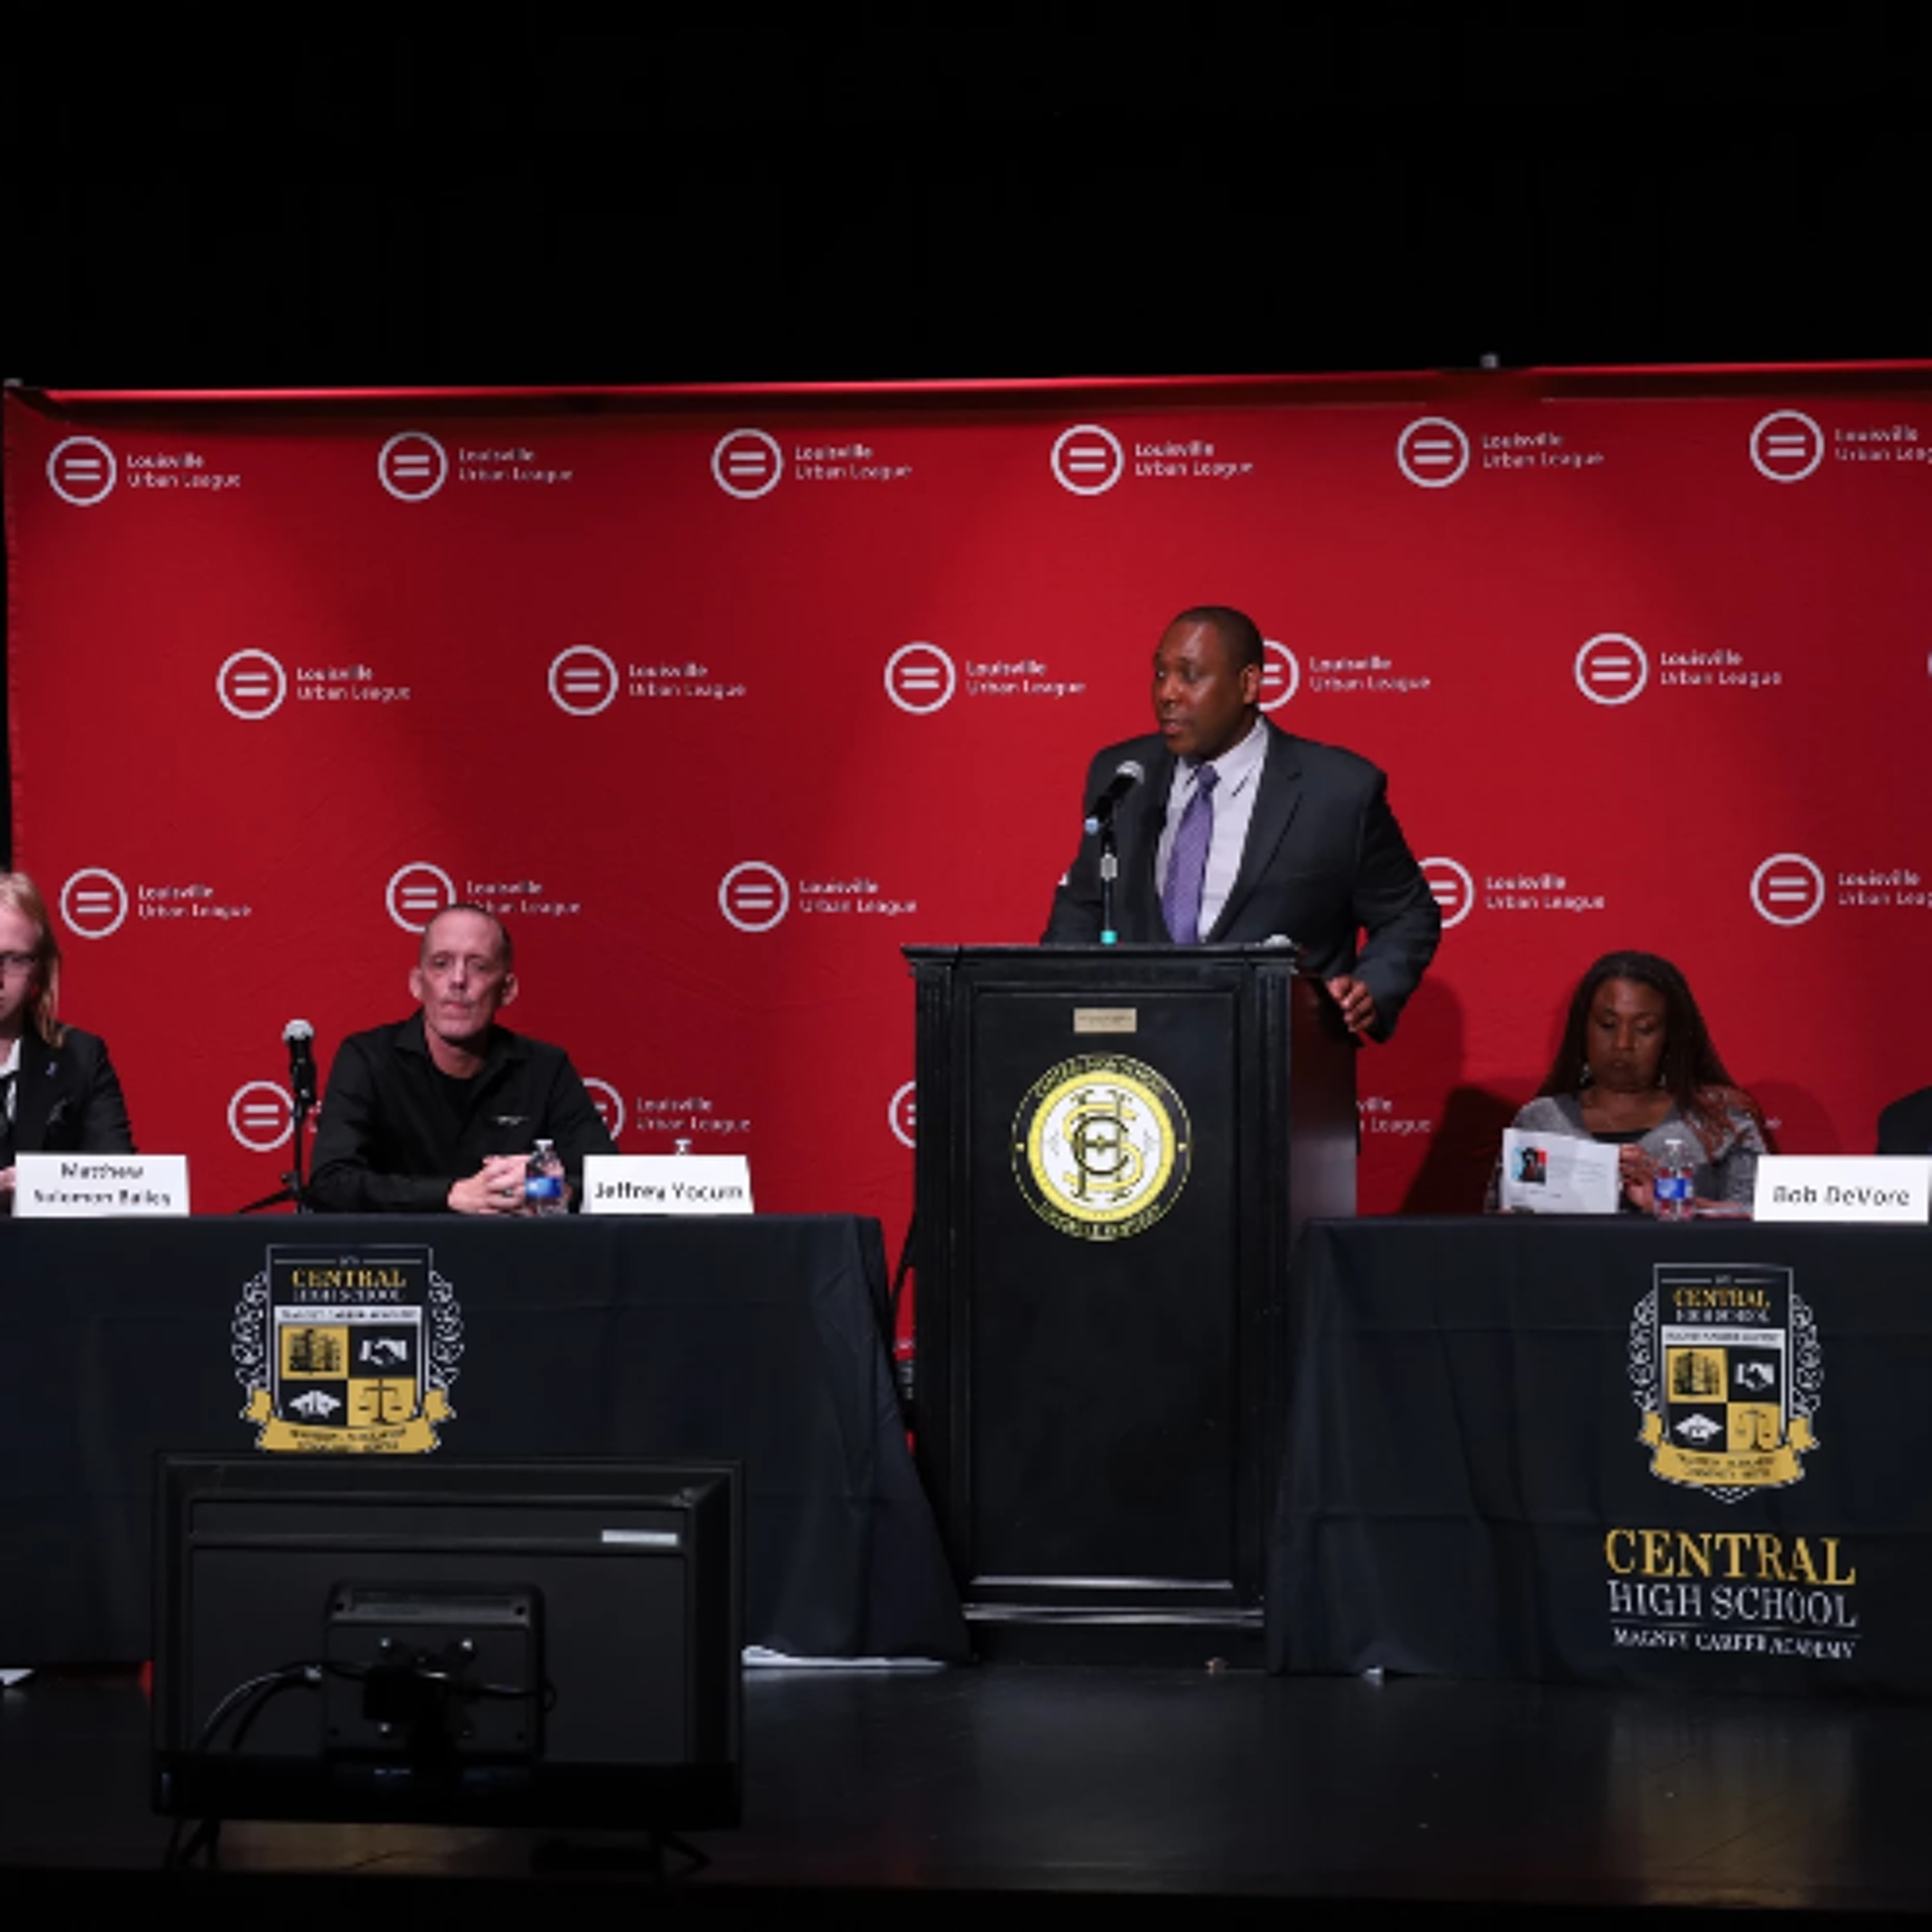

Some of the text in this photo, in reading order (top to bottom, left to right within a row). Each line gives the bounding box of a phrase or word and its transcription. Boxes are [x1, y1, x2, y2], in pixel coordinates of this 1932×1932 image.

[1482, 432, 1562, 449] Louisville
[1835, 425, 1918, 442] Louisville
[459, 448, 535, 462] Louisville
[795, 443, 873, 460] Louisville
[1135, 440, 1214, 457] Louisville
[1835, 448, 1890, 460] Urban
[127, 452, 205, 468] Louisville
[1483, 451, 1604, 468] Urban League
[459, 467, 573, 484] Urban League
[795, 464, 913, 480] Urban League
[1135, 460, 1253, 479] Urban League
[127, 471, 240, 491] Urban League
[1309, 655, 1392, 673] Louisville
[1660, 649, 1743, 666] Louisville
[296, 664, 373, 681] Louisville
[629, 662, 708, 677] Louisville
[965, 659, 1047, 677] Louisville
[1309, 676, 1431, 692] Urban League
[1661, 668, 1782, 688] Urban League
[297, 684, 410, 703] Urban League
[629, 681, 746, 700] Urban League
[966, 679, 1086, 699] Urban League
[799, 877, 879, 894] Louisville
[1485, 873, 1566, 890] Louisville
[1839, 869, 1920, 886] Louisville
[138, 884, 214, 901] Louisville
[467, 880, 542, 896] Louisville
[1485, 895, 1605, 913] Urban League
[1839, 890, 1890, 905] Urban
[138, 903, 252, 920] Urban League
[521, 900, 580, 916] League
[799, 898, 917, 916] Urban League
[637, 1097, 712, 1112] Louisville
[637, 1116, 750, 1135] Urban League
[1370, 1116, 1431, 1136] League
[595, 1181, 666, 1202] Jeffrey
[1824, 1185, 1910, 1206] DeVore
[292, 1269, 407, 1288] CENTRAL
[1673, 1287, 1771, 1308] CENTRAL
[1604, 1528, 1856, 1586] CENTRAL
[1608, 1579, 1858, 1628] HIGH SCHOOL
